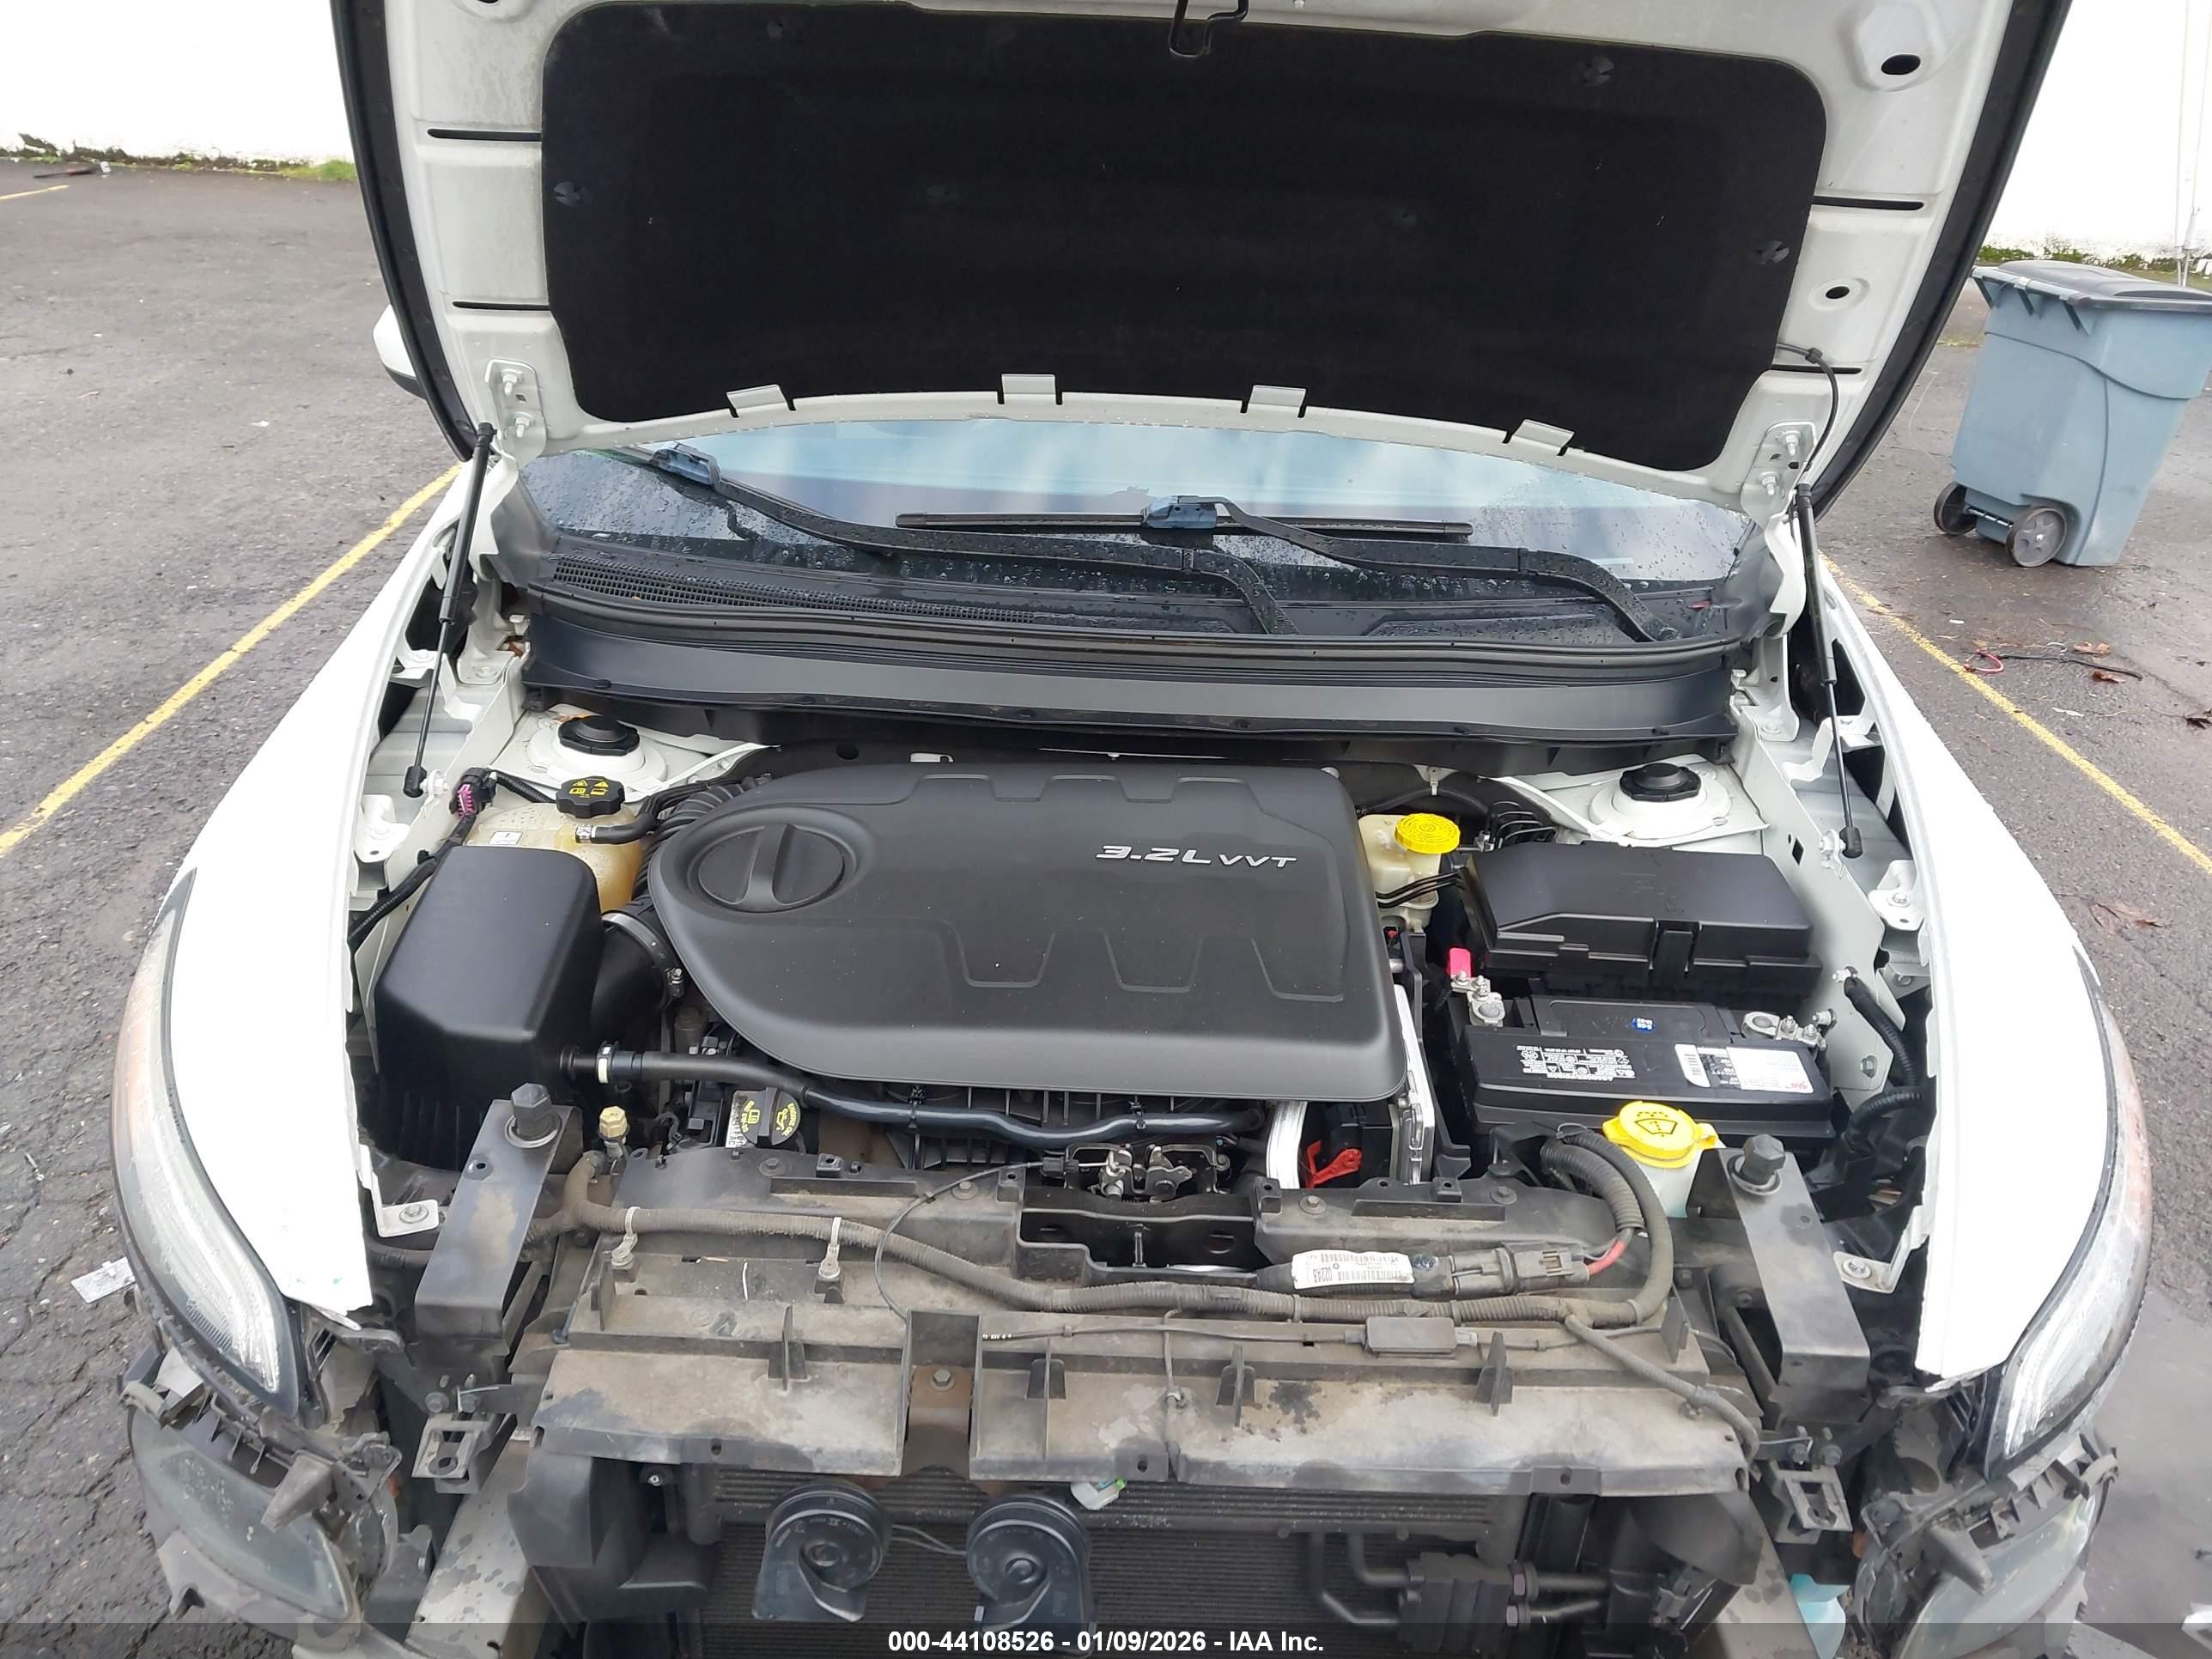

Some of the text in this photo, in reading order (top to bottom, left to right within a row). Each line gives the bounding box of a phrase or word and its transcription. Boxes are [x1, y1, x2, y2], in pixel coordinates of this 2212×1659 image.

[1095, 845, 1297, 868] 3.2L VVT
[744, 1100, 755, 1111] SAE
[782, 1103, 797, 1136] ENGINE OIL
